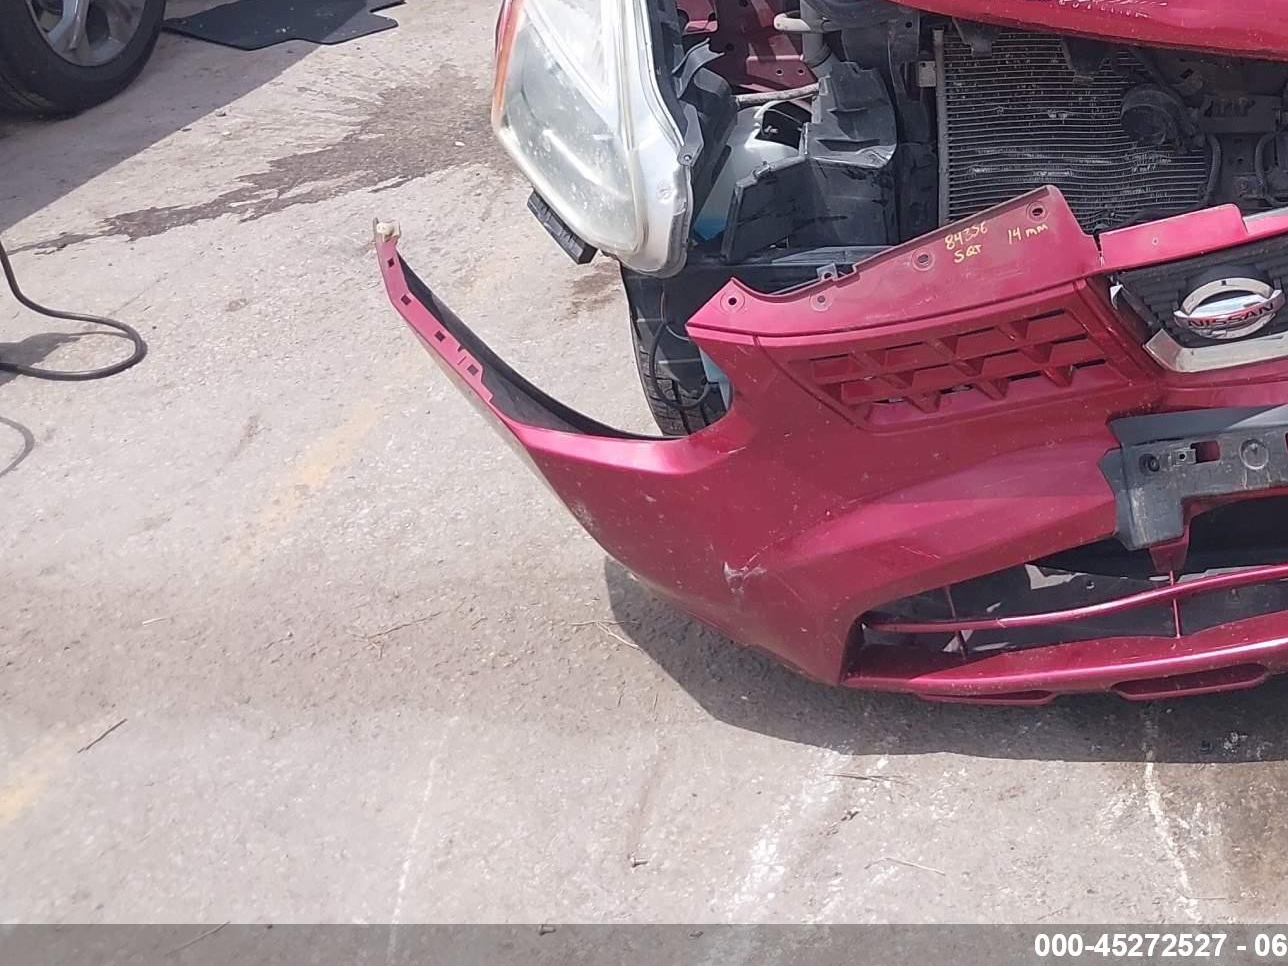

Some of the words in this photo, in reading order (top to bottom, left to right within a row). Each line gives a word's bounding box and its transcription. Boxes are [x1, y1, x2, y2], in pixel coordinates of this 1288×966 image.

[1007, 226, 1022, 245] 14
[1025, 223, 1049, 238] mm
[1187, 301, 1275, 328] NISSAN
